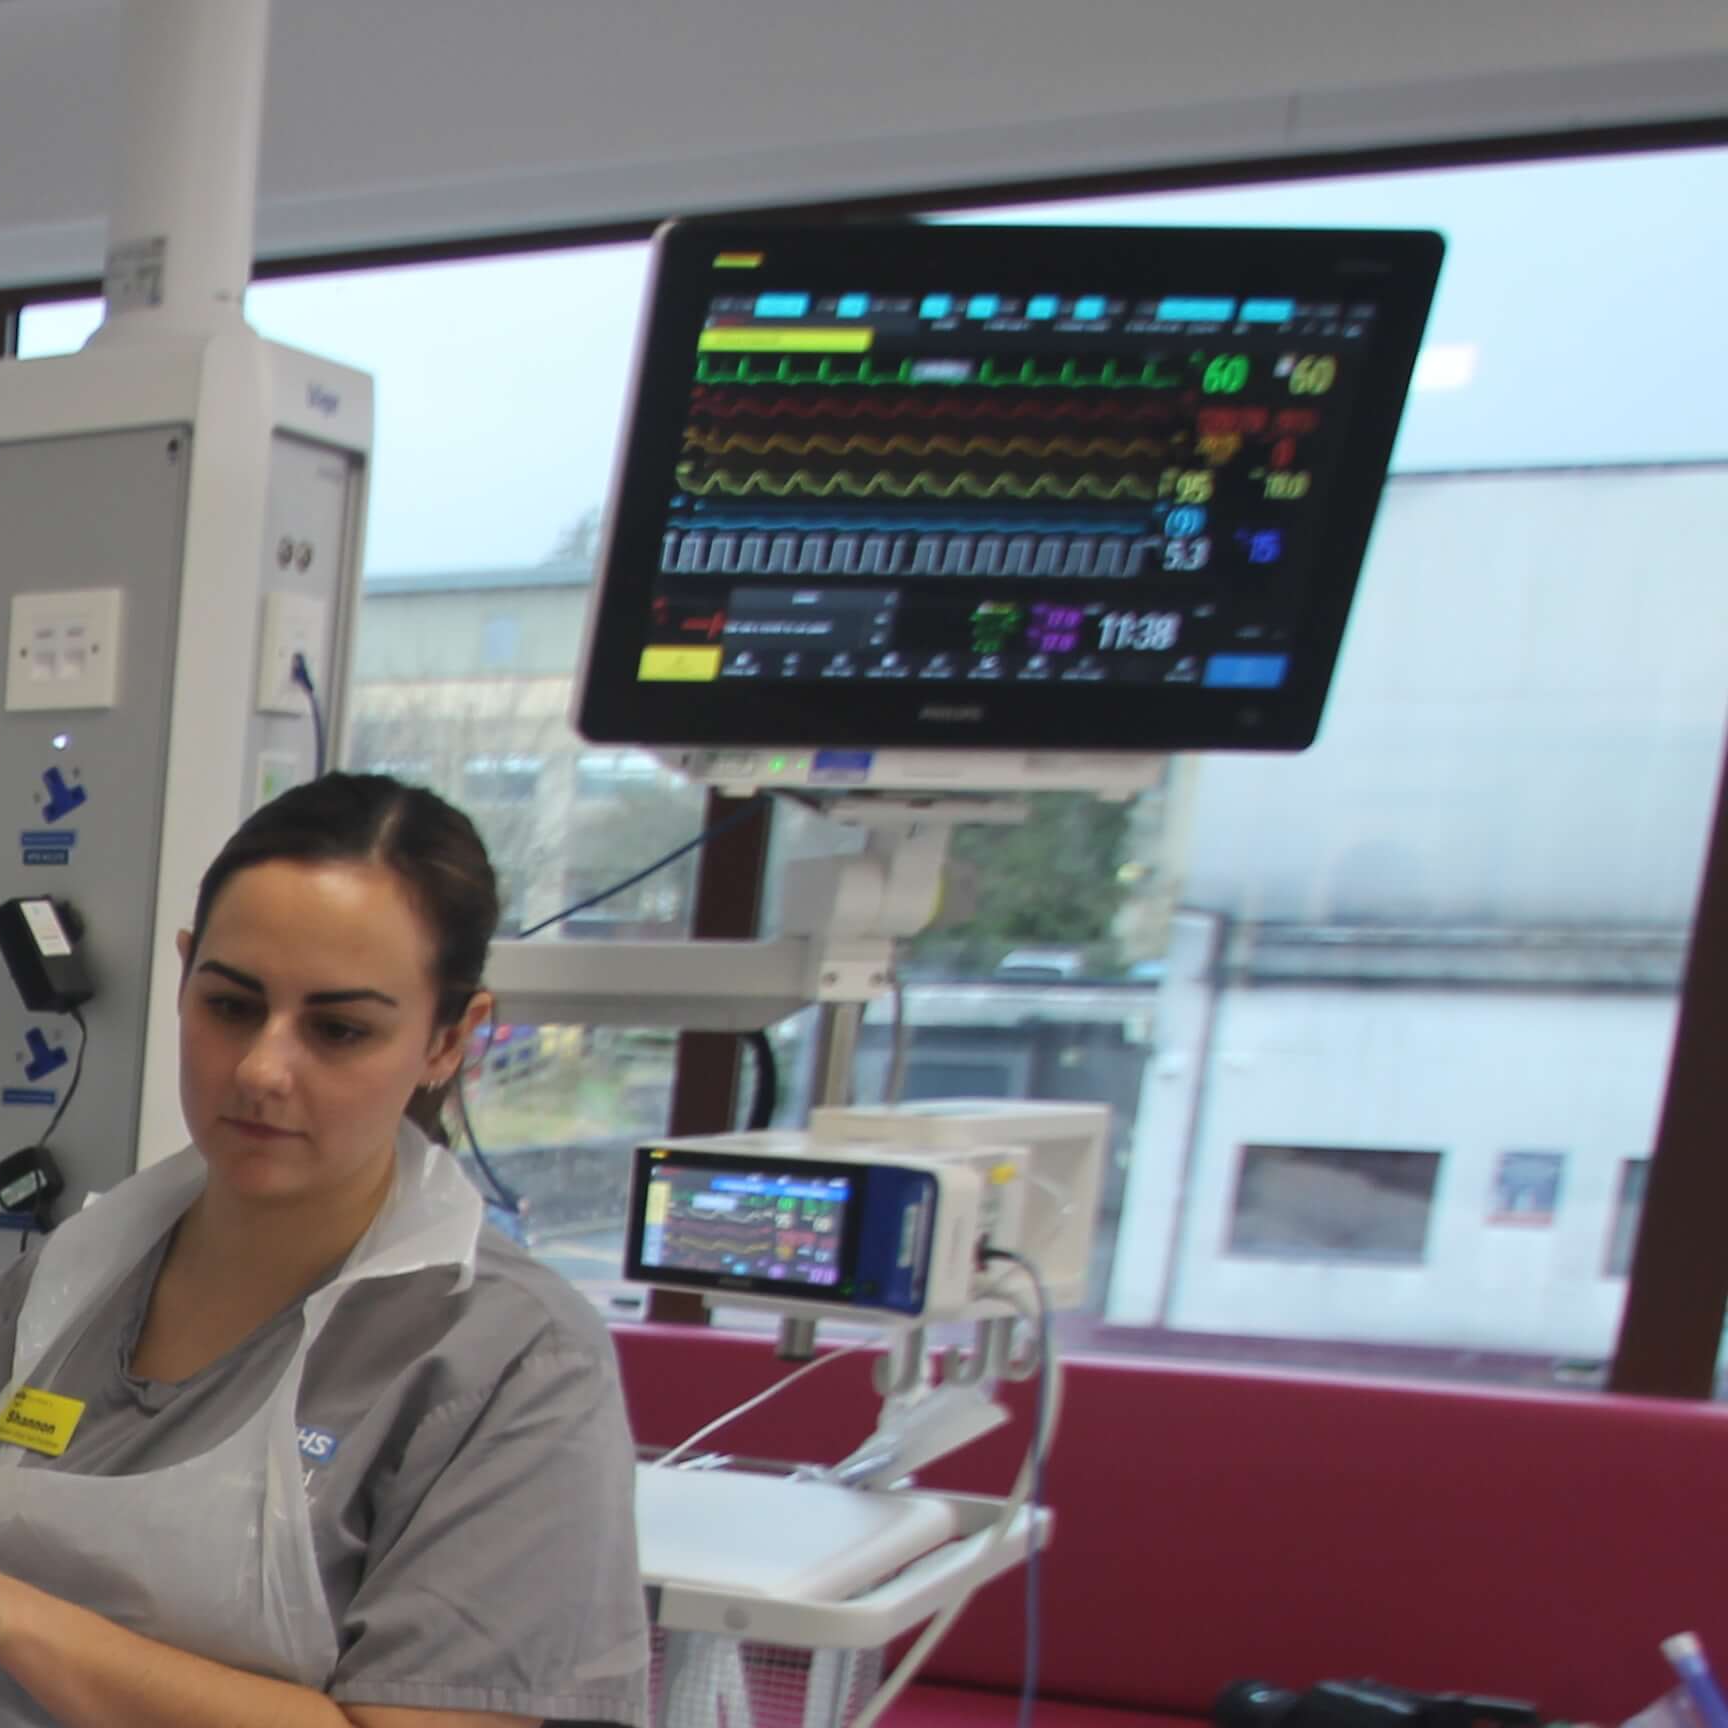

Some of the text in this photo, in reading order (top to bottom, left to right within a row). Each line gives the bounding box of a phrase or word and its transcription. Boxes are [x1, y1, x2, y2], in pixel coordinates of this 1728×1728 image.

[1201, 353, 1338, 396] 60 60
[1098, 611, 1183, 651] 11:38
[297, 1427, 334, 1456] HS
